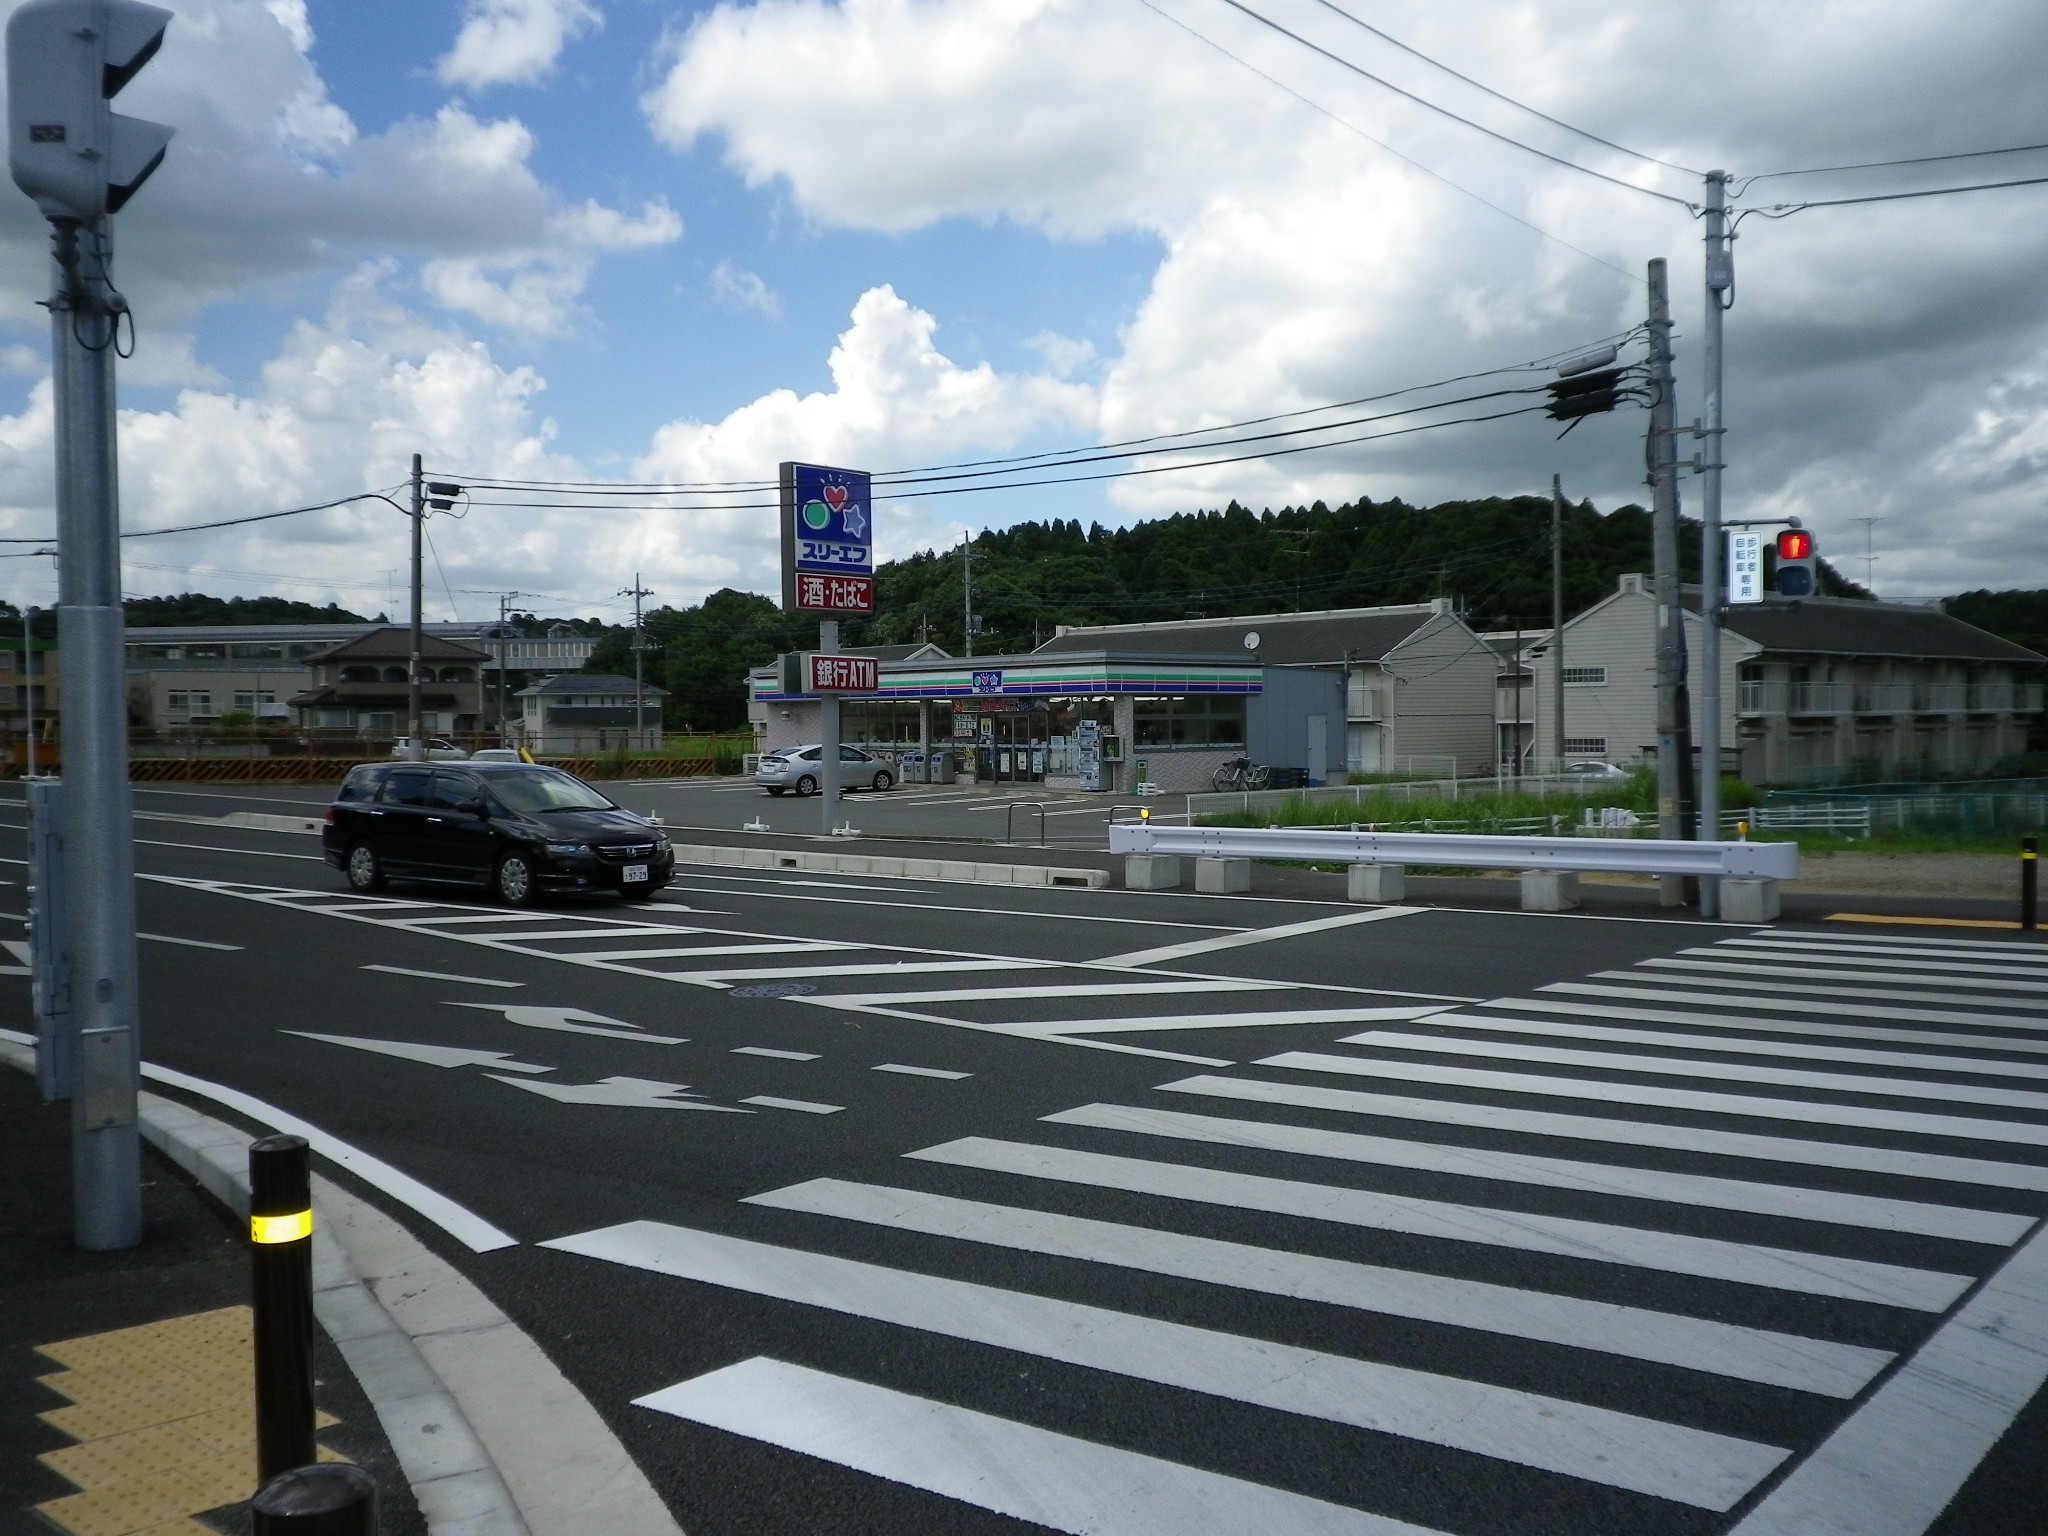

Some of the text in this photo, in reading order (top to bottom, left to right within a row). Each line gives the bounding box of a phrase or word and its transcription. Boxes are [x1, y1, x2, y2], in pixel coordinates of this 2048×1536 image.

[802, 542, 867, 563] スリーエフ
[802, 576, 869, 609] 酒・たばこ
[816, 659, 875, 688] 銀行ATM
